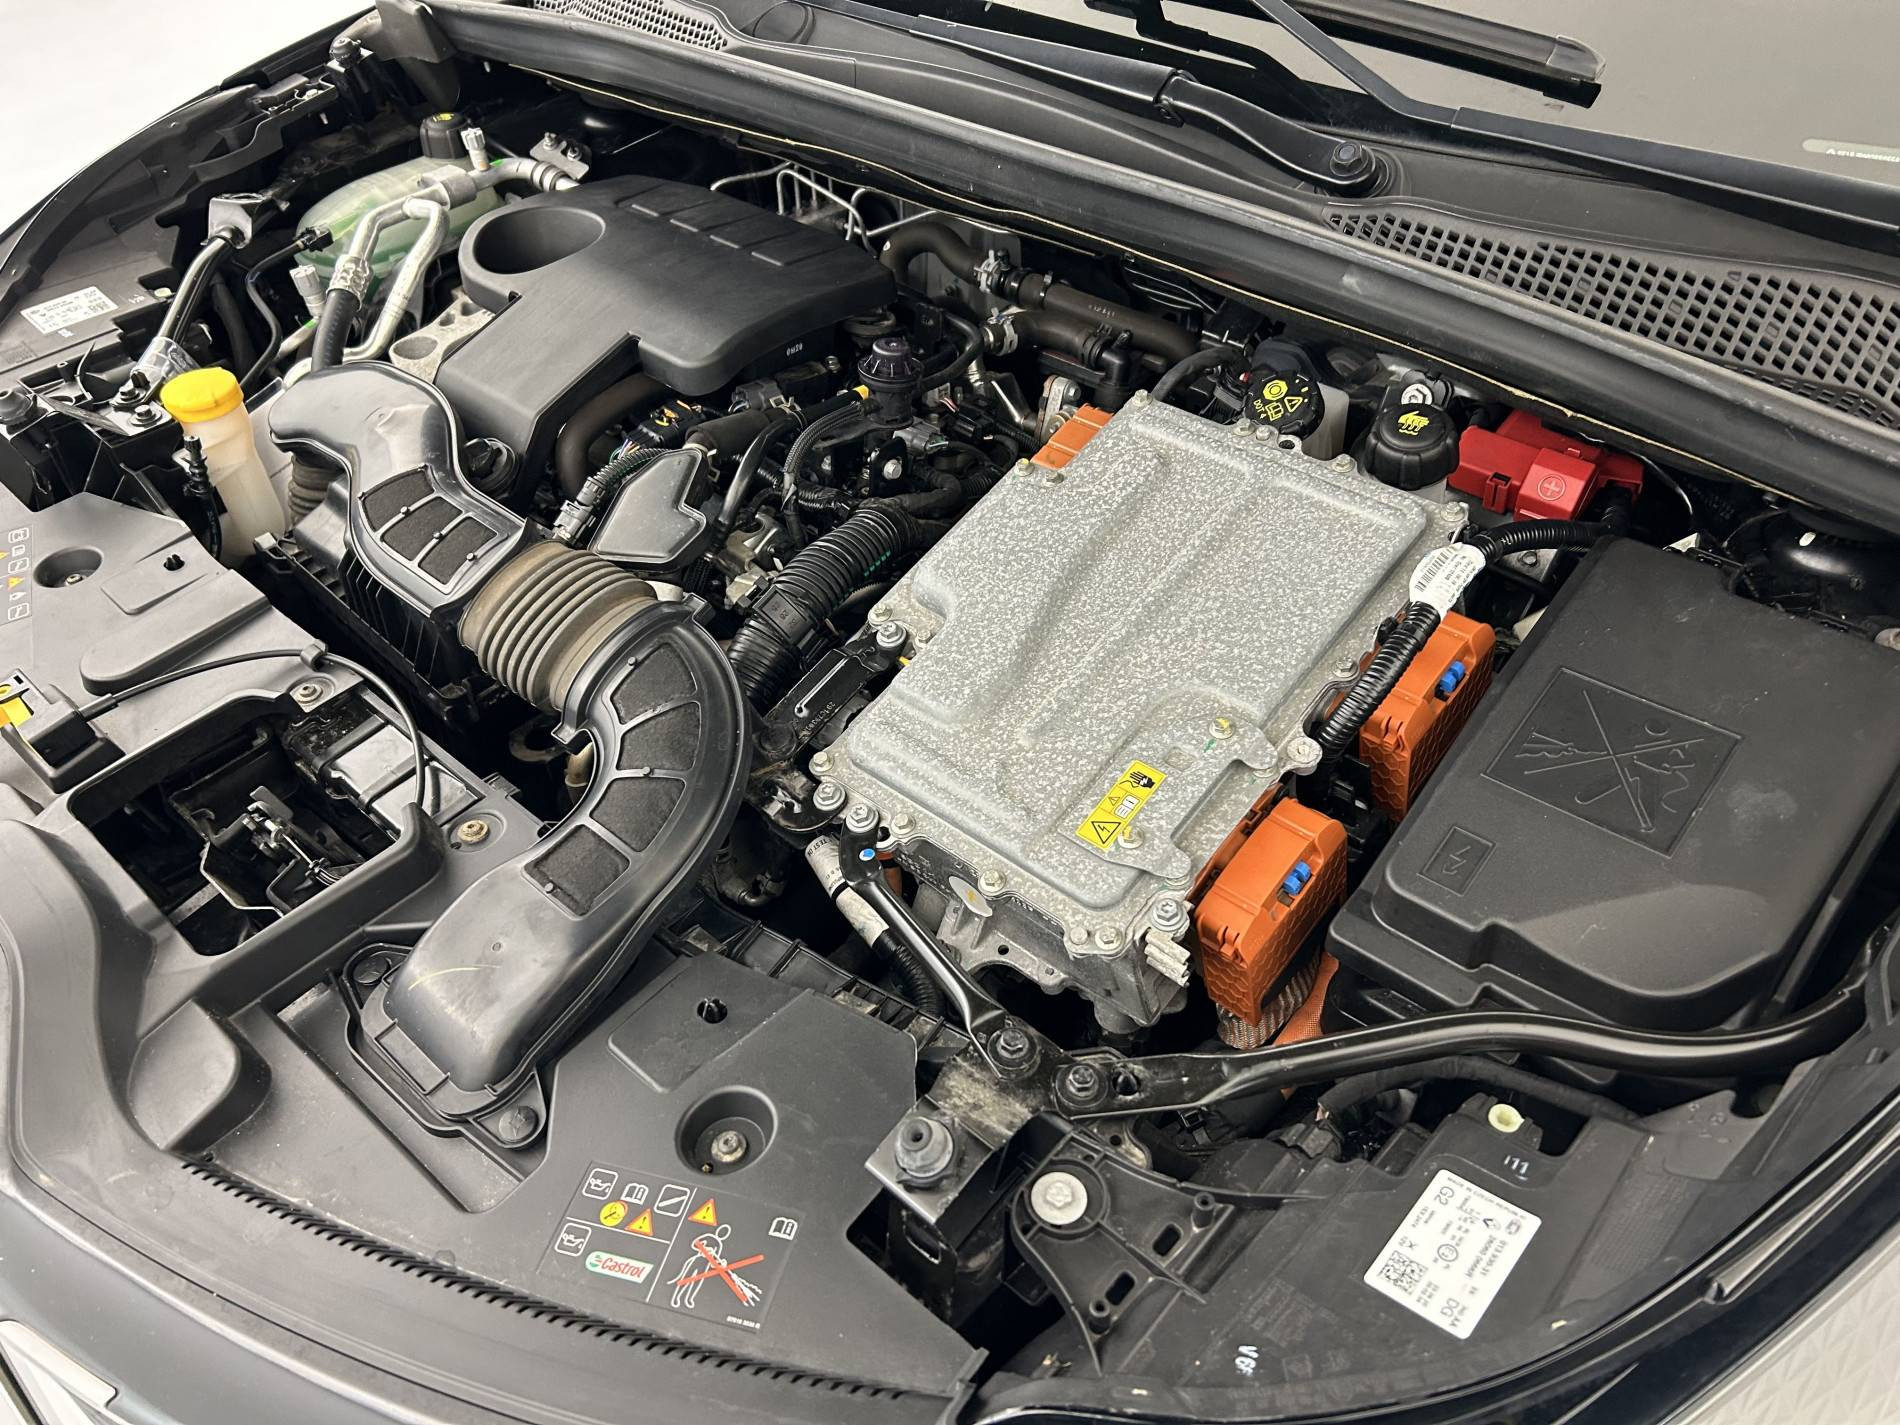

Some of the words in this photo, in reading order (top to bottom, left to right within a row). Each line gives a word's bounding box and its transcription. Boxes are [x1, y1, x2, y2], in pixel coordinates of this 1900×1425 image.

[1254, 399, 1265, 412] DOT
[813, 839, 828, 851] TEST
[1434, 1186, 1455, 1206] G2
[601, 1257, 646, 1278] Castrol
[1440, 1297, 1461, 1318] DG
